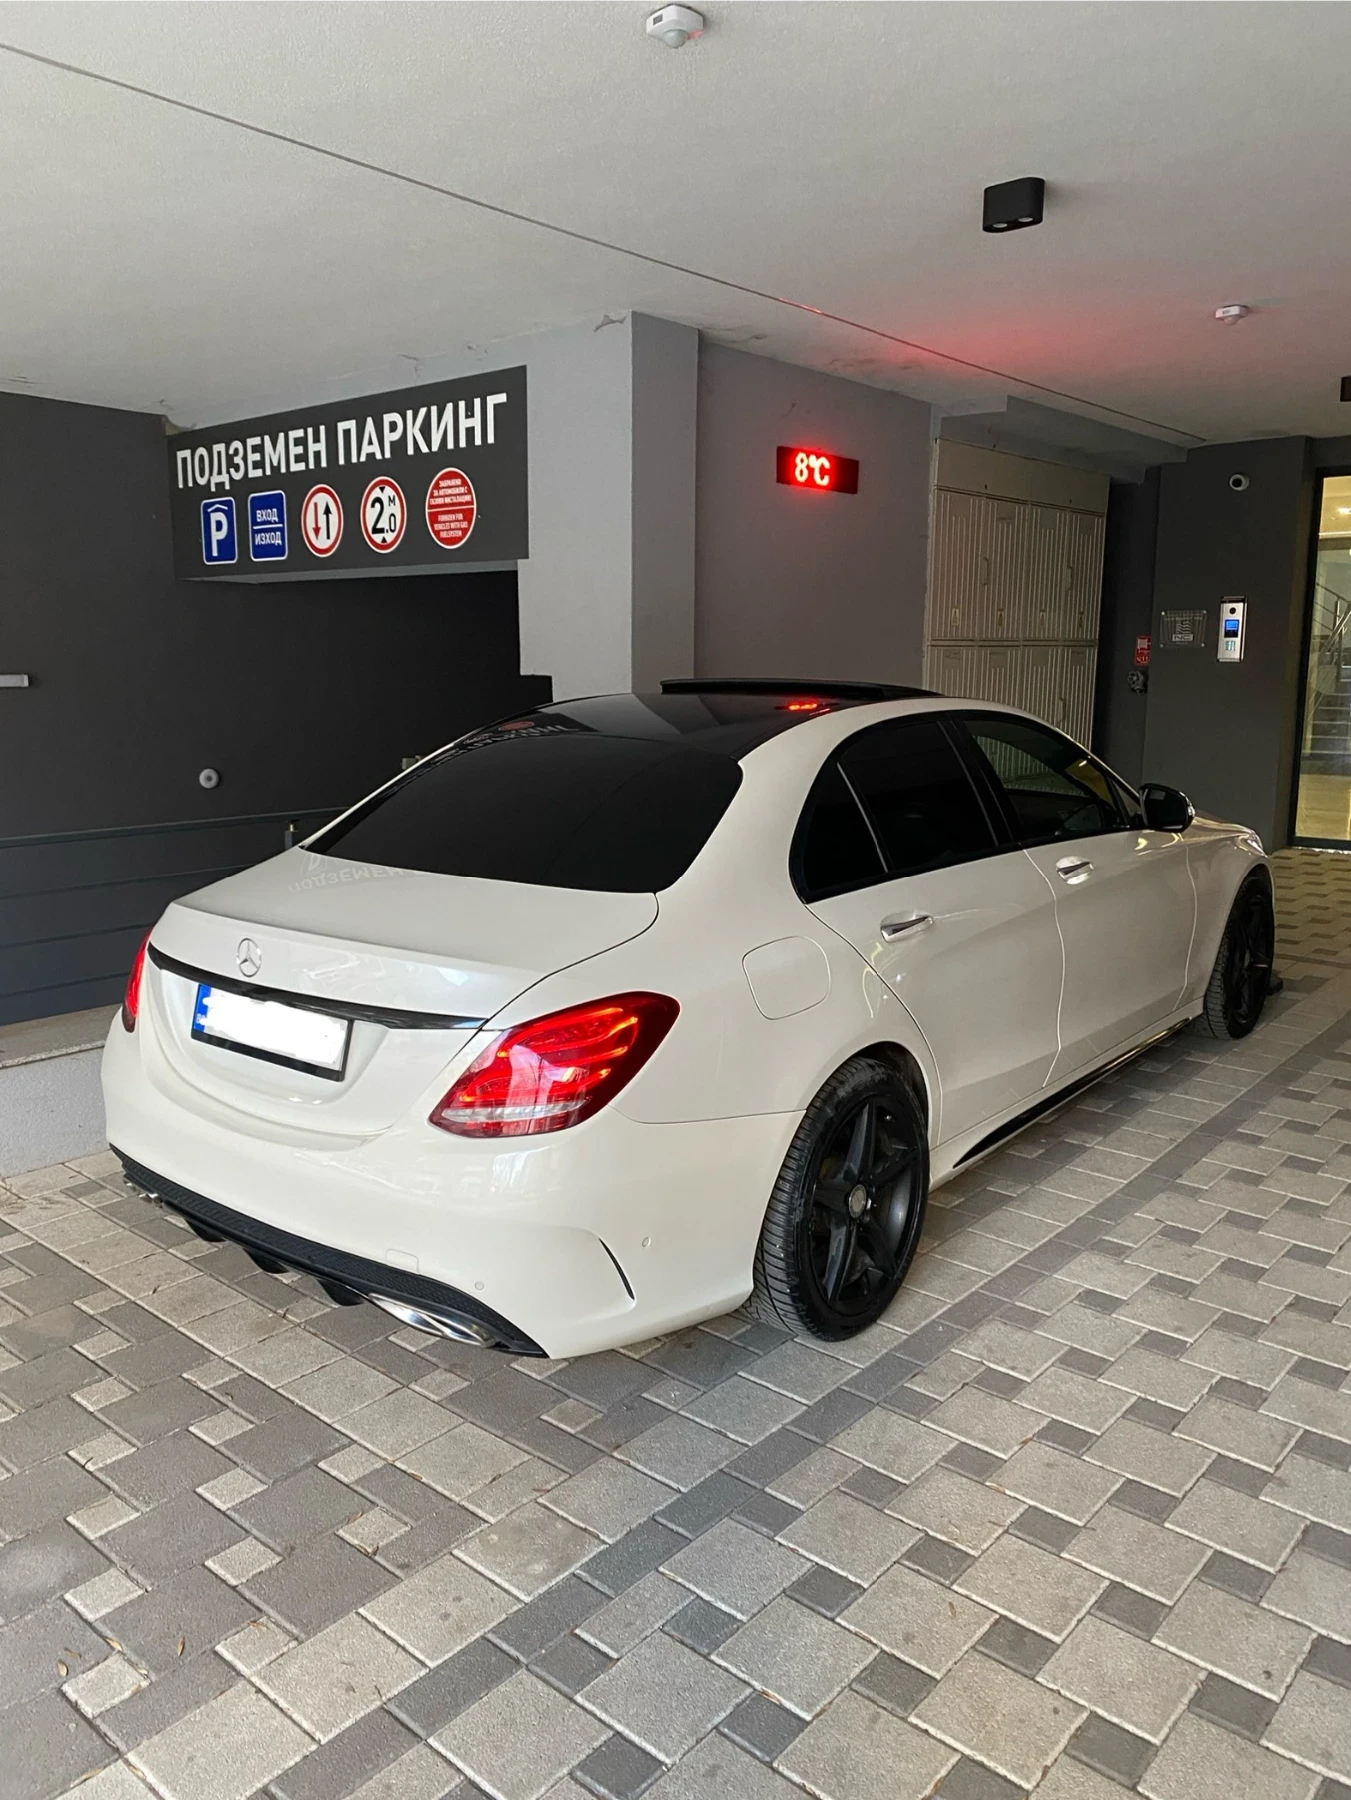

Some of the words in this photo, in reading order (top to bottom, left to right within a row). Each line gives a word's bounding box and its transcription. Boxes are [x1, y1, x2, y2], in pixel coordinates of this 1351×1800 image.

[176, 425, 327, 492] ПОДЗЕМЕН
[337, 393, 507, 465] ПАРКИНГ
[256, 508, 278, 523] ВХОД
[210, 511, 228, 557] P
[254, 531, 282, 546] ИЗХОД
